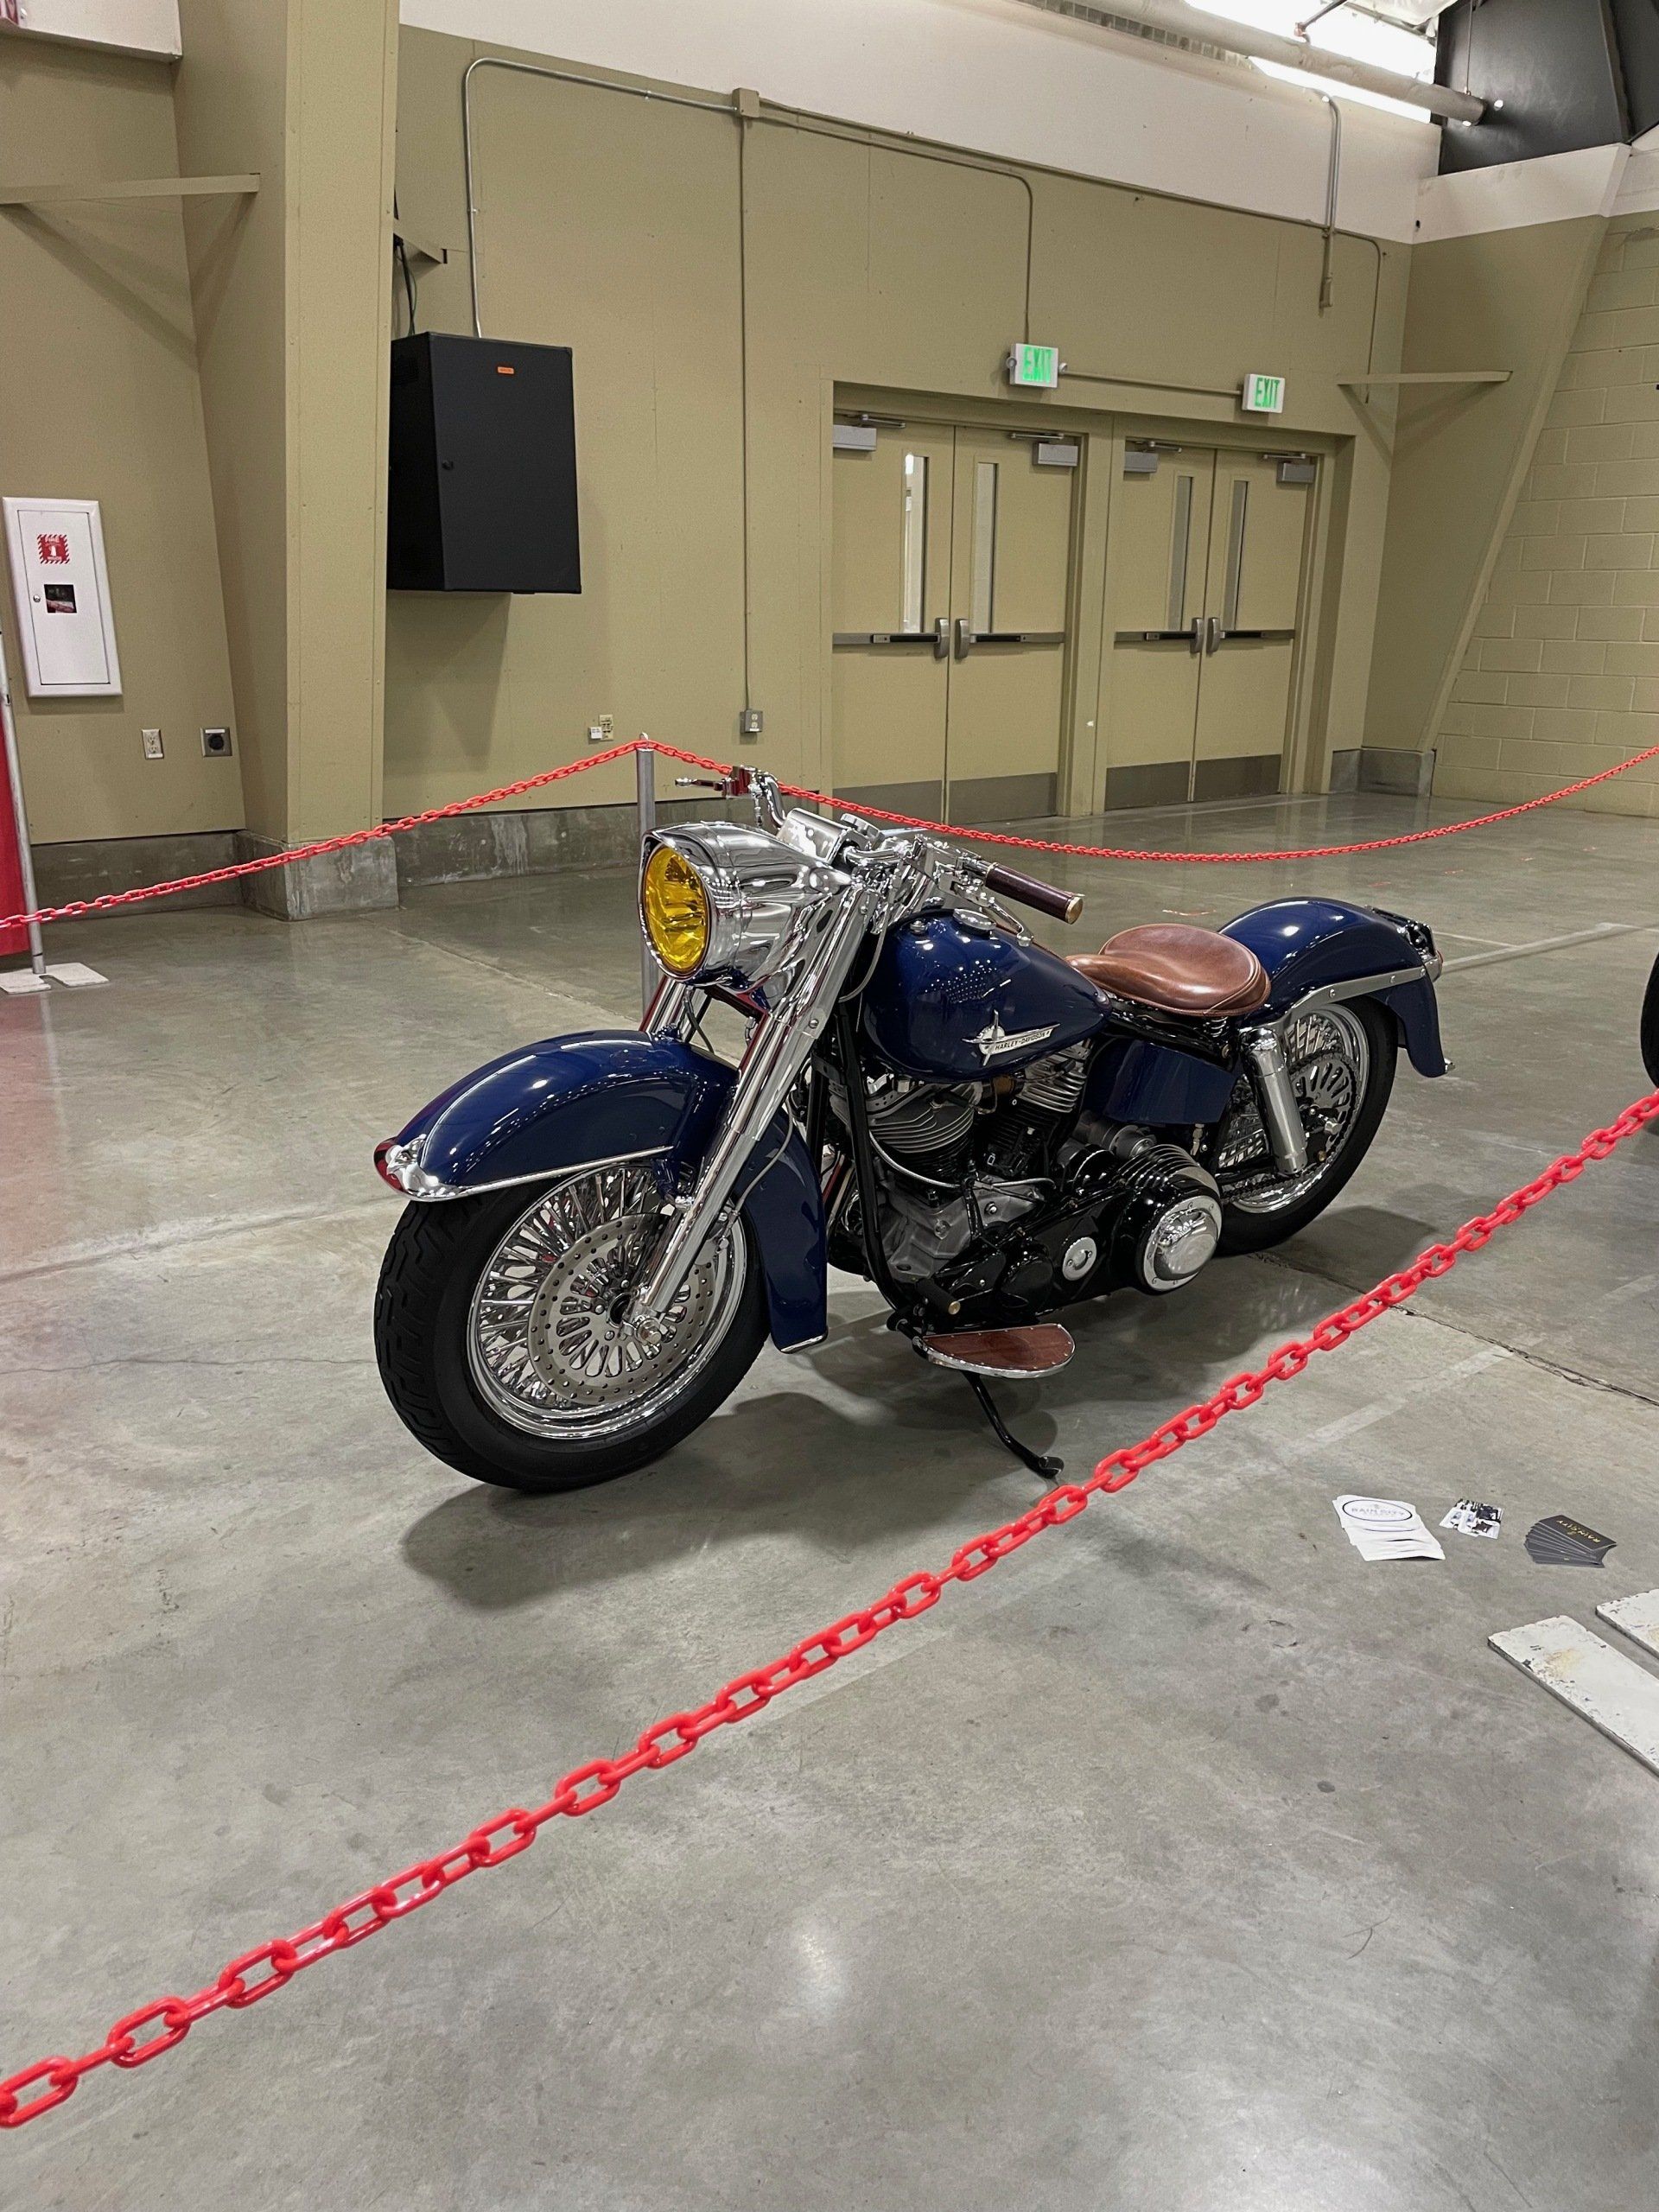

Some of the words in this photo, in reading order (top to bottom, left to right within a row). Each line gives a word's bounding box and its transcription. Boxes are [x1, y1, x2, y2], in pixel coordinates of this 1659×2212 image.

[1023, 346, 1052, 383] EXIT
[1255, 377, 1281, 409] EXIT
[995, 1032, 1046, 1051] HARLEY-DAVIDSON
